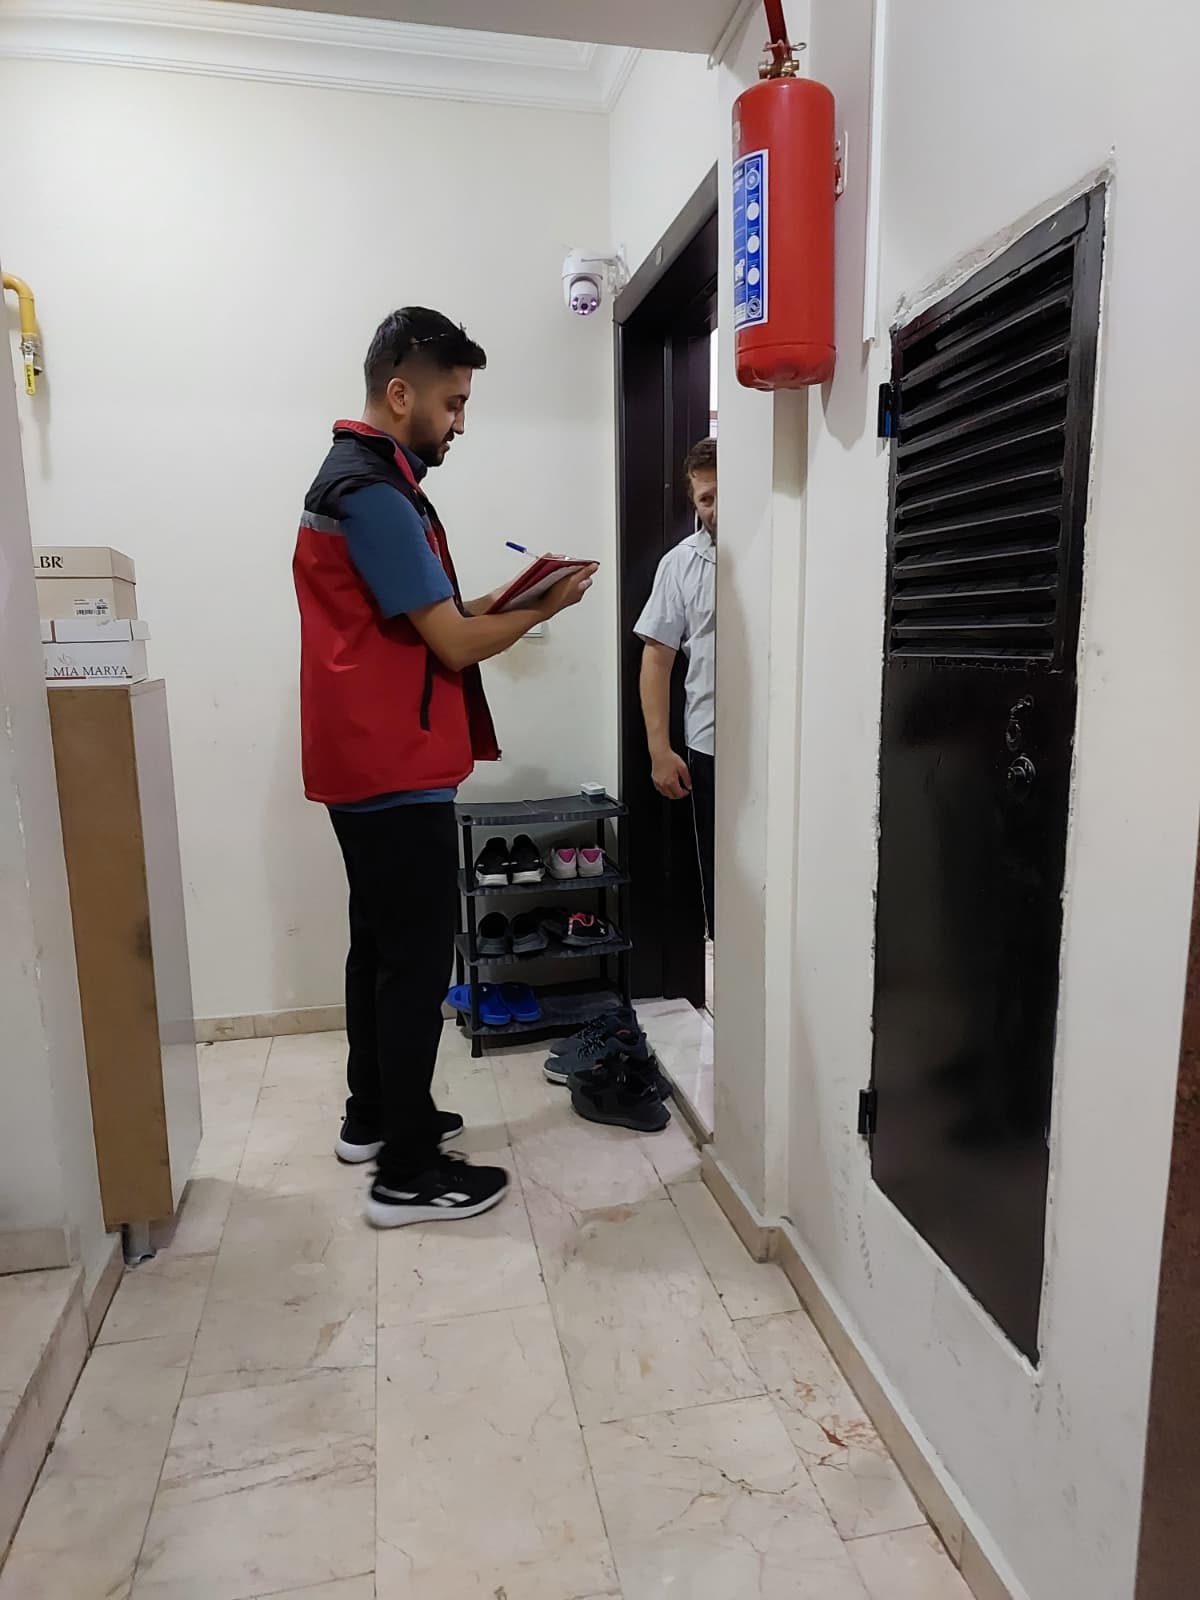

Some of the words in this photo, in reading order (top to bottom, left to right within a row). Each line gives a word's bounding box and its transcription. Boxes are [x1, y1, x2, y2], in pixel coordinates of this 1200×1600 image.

[33, 555, 63, 569] BR
[53, 666, 79, 677] MIA
[82, 665, 129, 676] MARYA
